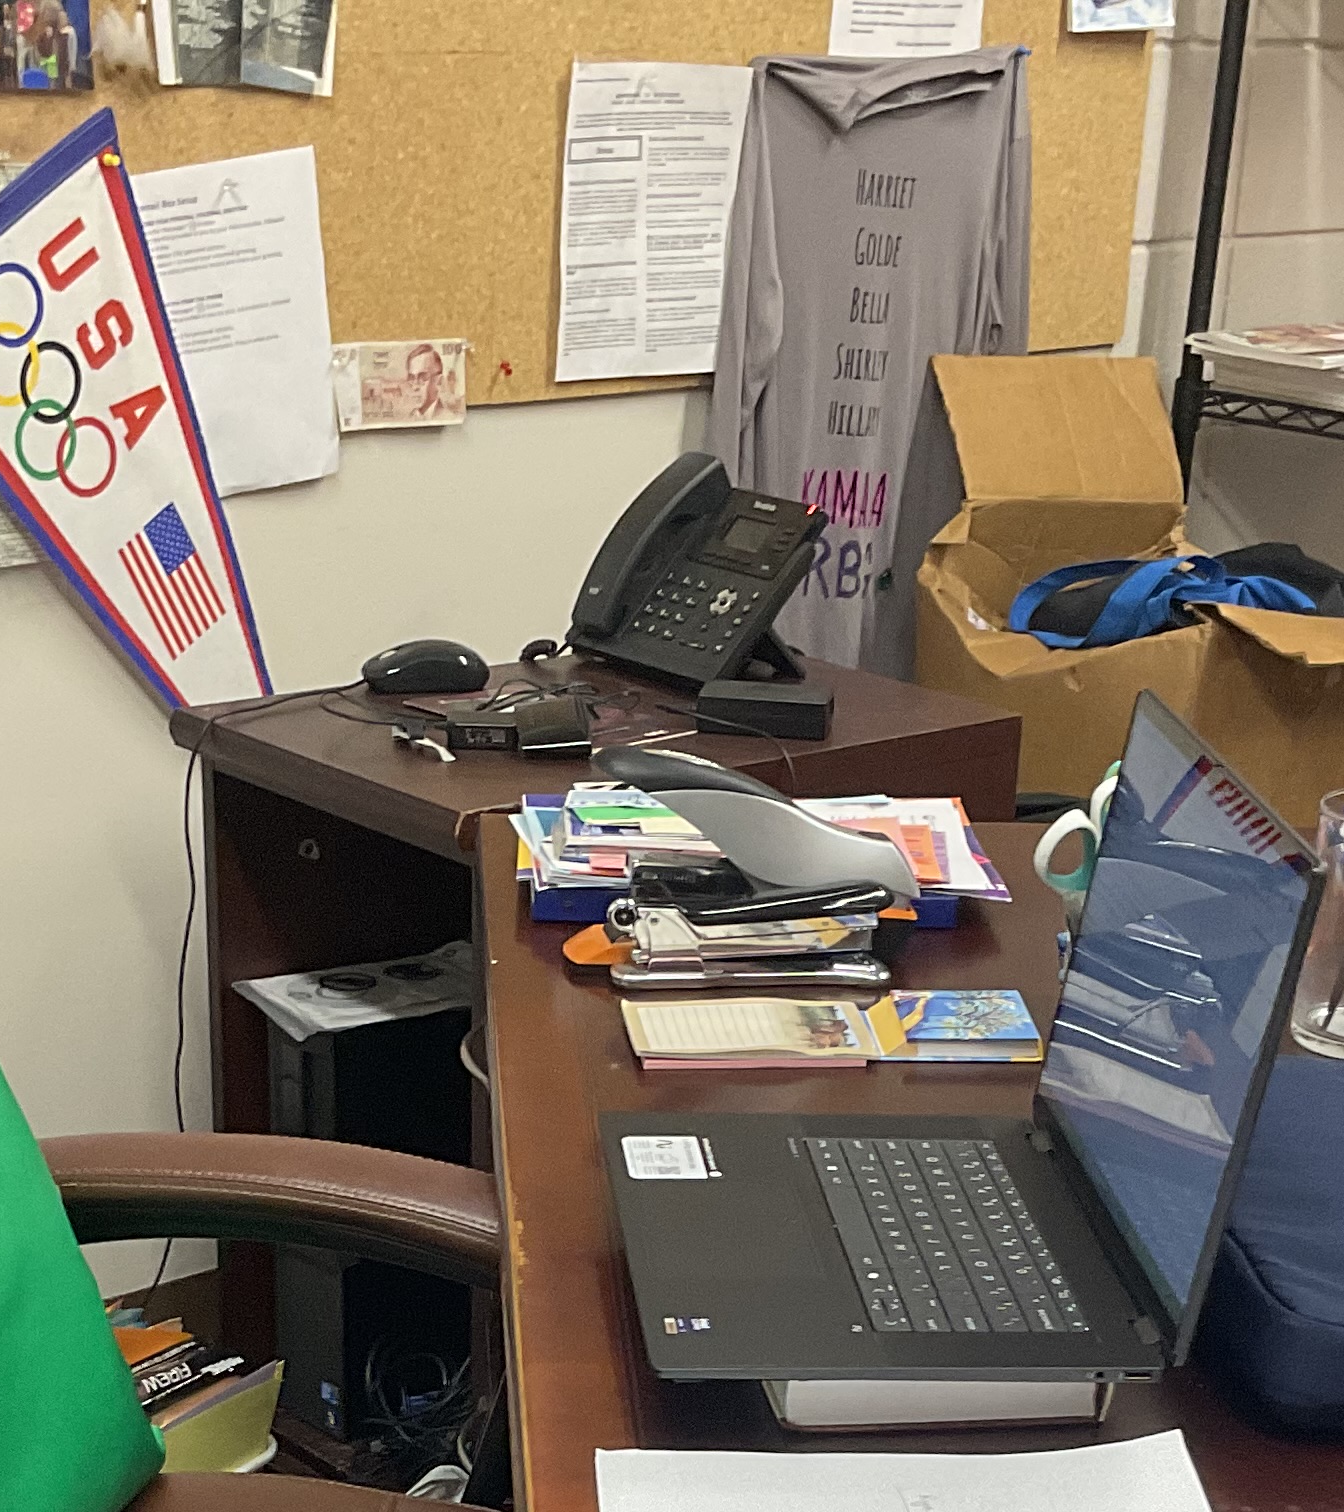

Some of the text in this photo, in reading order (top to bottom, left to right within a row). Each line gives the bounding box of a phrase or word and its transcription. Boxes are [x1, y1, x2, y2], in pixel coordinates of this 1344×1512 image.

[856, 168, 918, 209] HARRIET
[855, 227, 903, 268] GOLDE
[37, 217, 167, 450] USA
